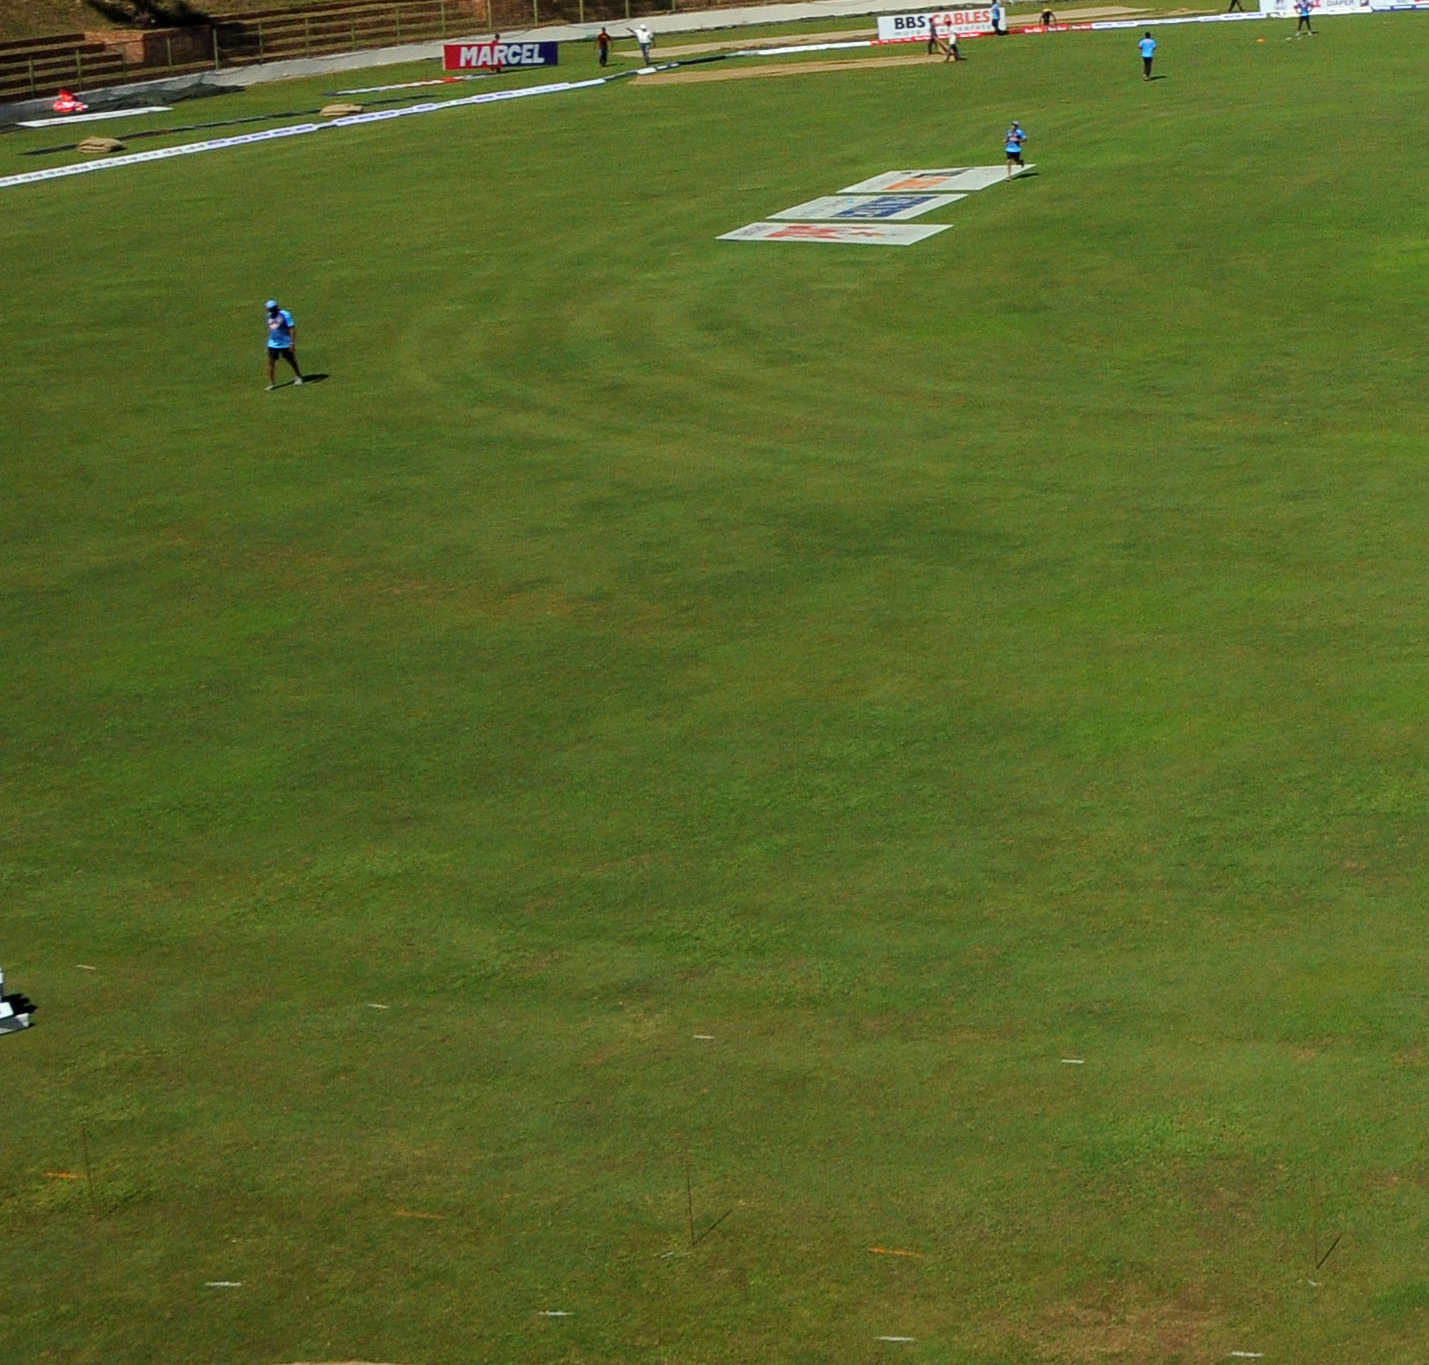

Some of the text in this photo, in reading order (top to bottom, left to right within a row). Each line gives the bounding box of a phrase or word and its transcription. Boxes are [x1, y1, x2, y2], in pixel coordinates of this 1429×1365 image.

[894, 15, 926, 30] BBS
[931, 10, 991, 27] CABLES
[460, 44, 545, 67] MARCEL
